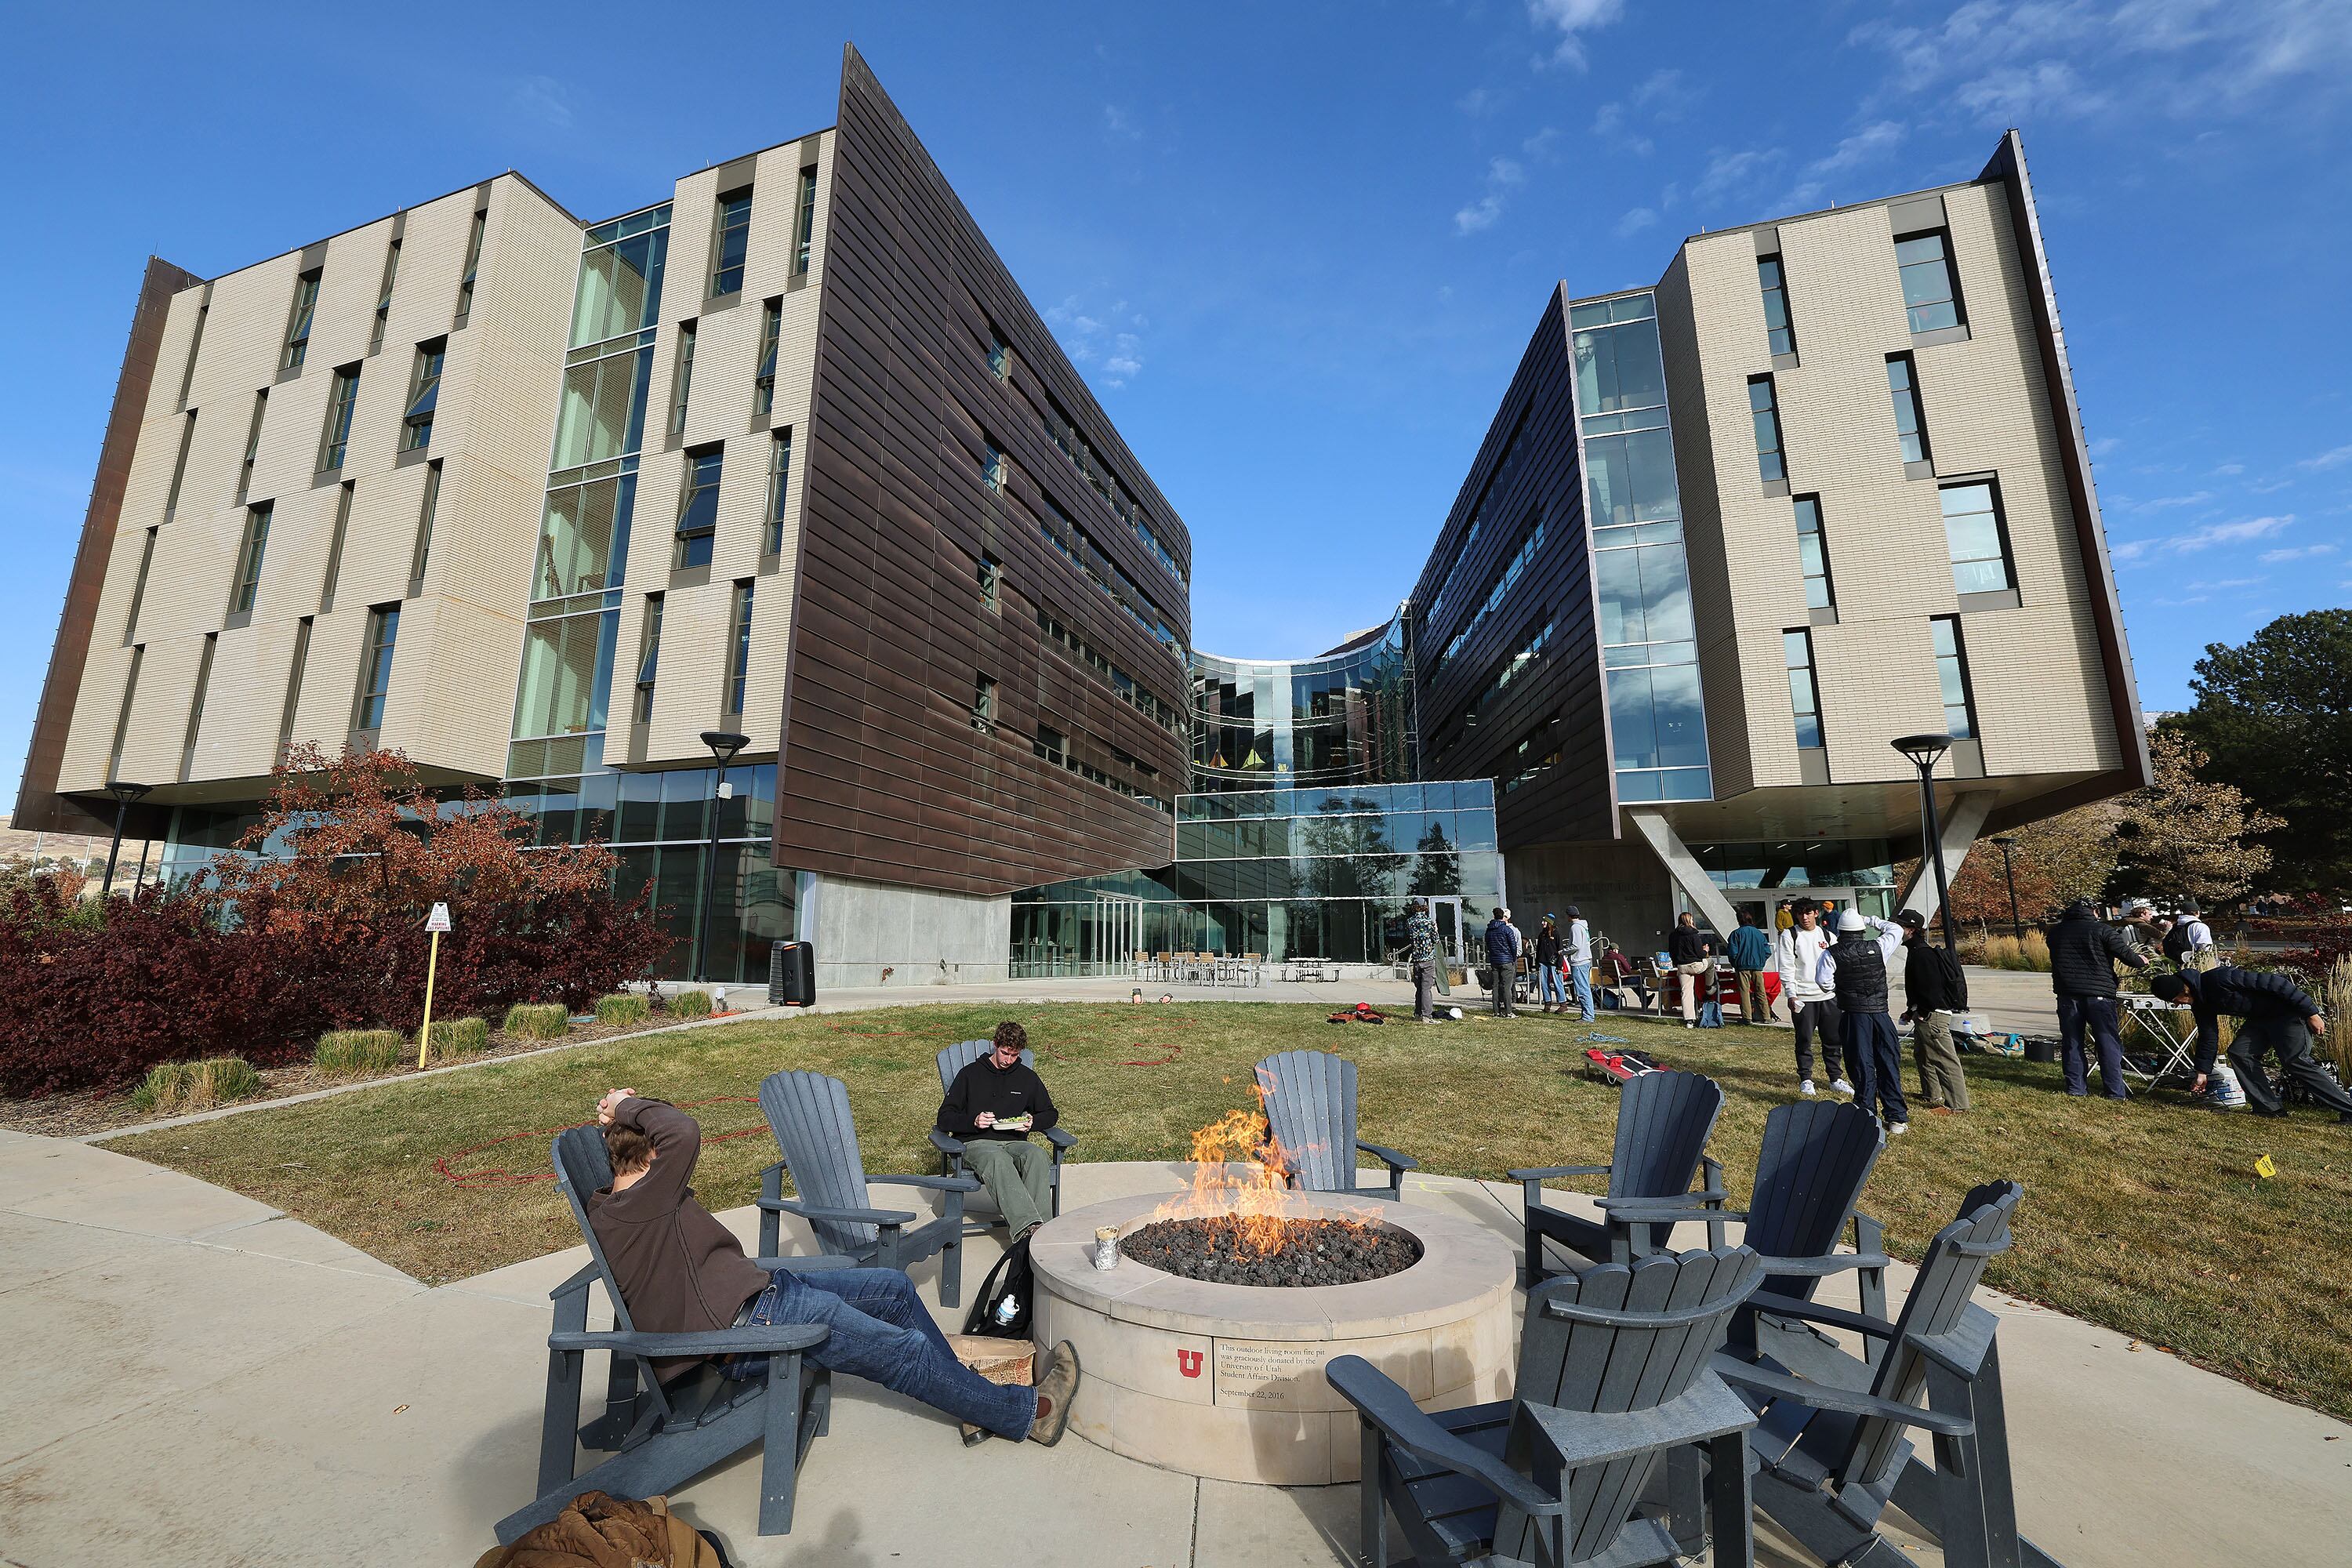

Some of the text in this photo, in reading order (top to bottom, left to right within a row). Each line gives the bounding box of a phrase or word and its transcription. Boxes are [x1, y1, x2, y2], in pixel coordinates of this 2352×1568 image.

[1265, 1347, 1283, 1356] living
[1316, 1348, 1325, 1357] pit
[1178, 1348, 1203, 1378] U
[1221, 1361, 1252, 1371] University
[1296, 1357, 1304, 1366] by
[1220, 1388, 1255, 1397] September
[1256, 1391, 1267, 1399] 22,
